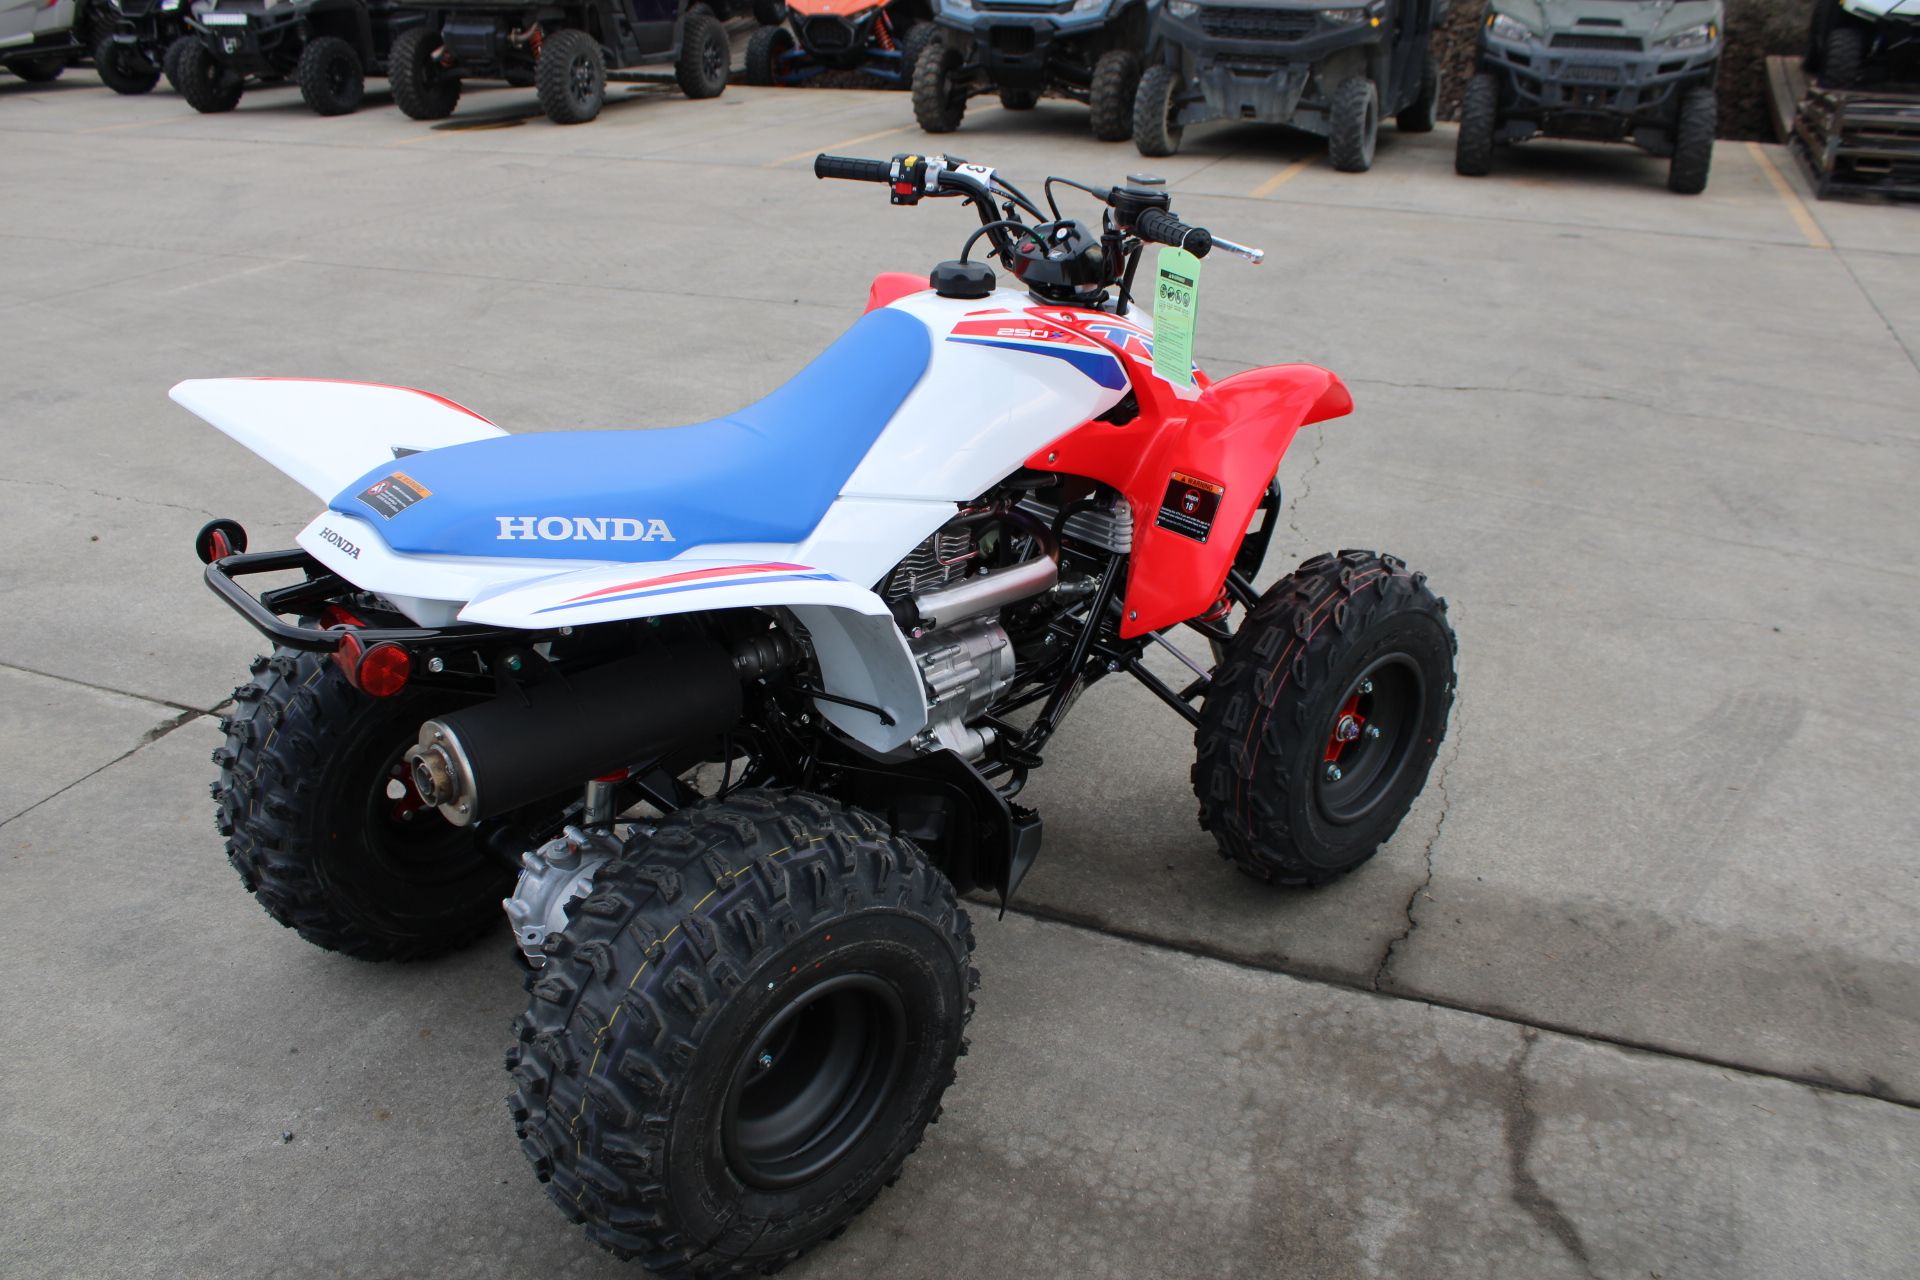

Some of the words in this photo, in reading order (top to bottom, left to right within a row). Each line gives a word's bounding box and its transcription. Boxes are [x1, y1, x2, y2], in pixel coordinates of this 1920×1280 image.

[1185, 502, 1194, 511] 16
[496, 516, 677, 542] HONDA
[319, 527, 361, 560] HONDA
